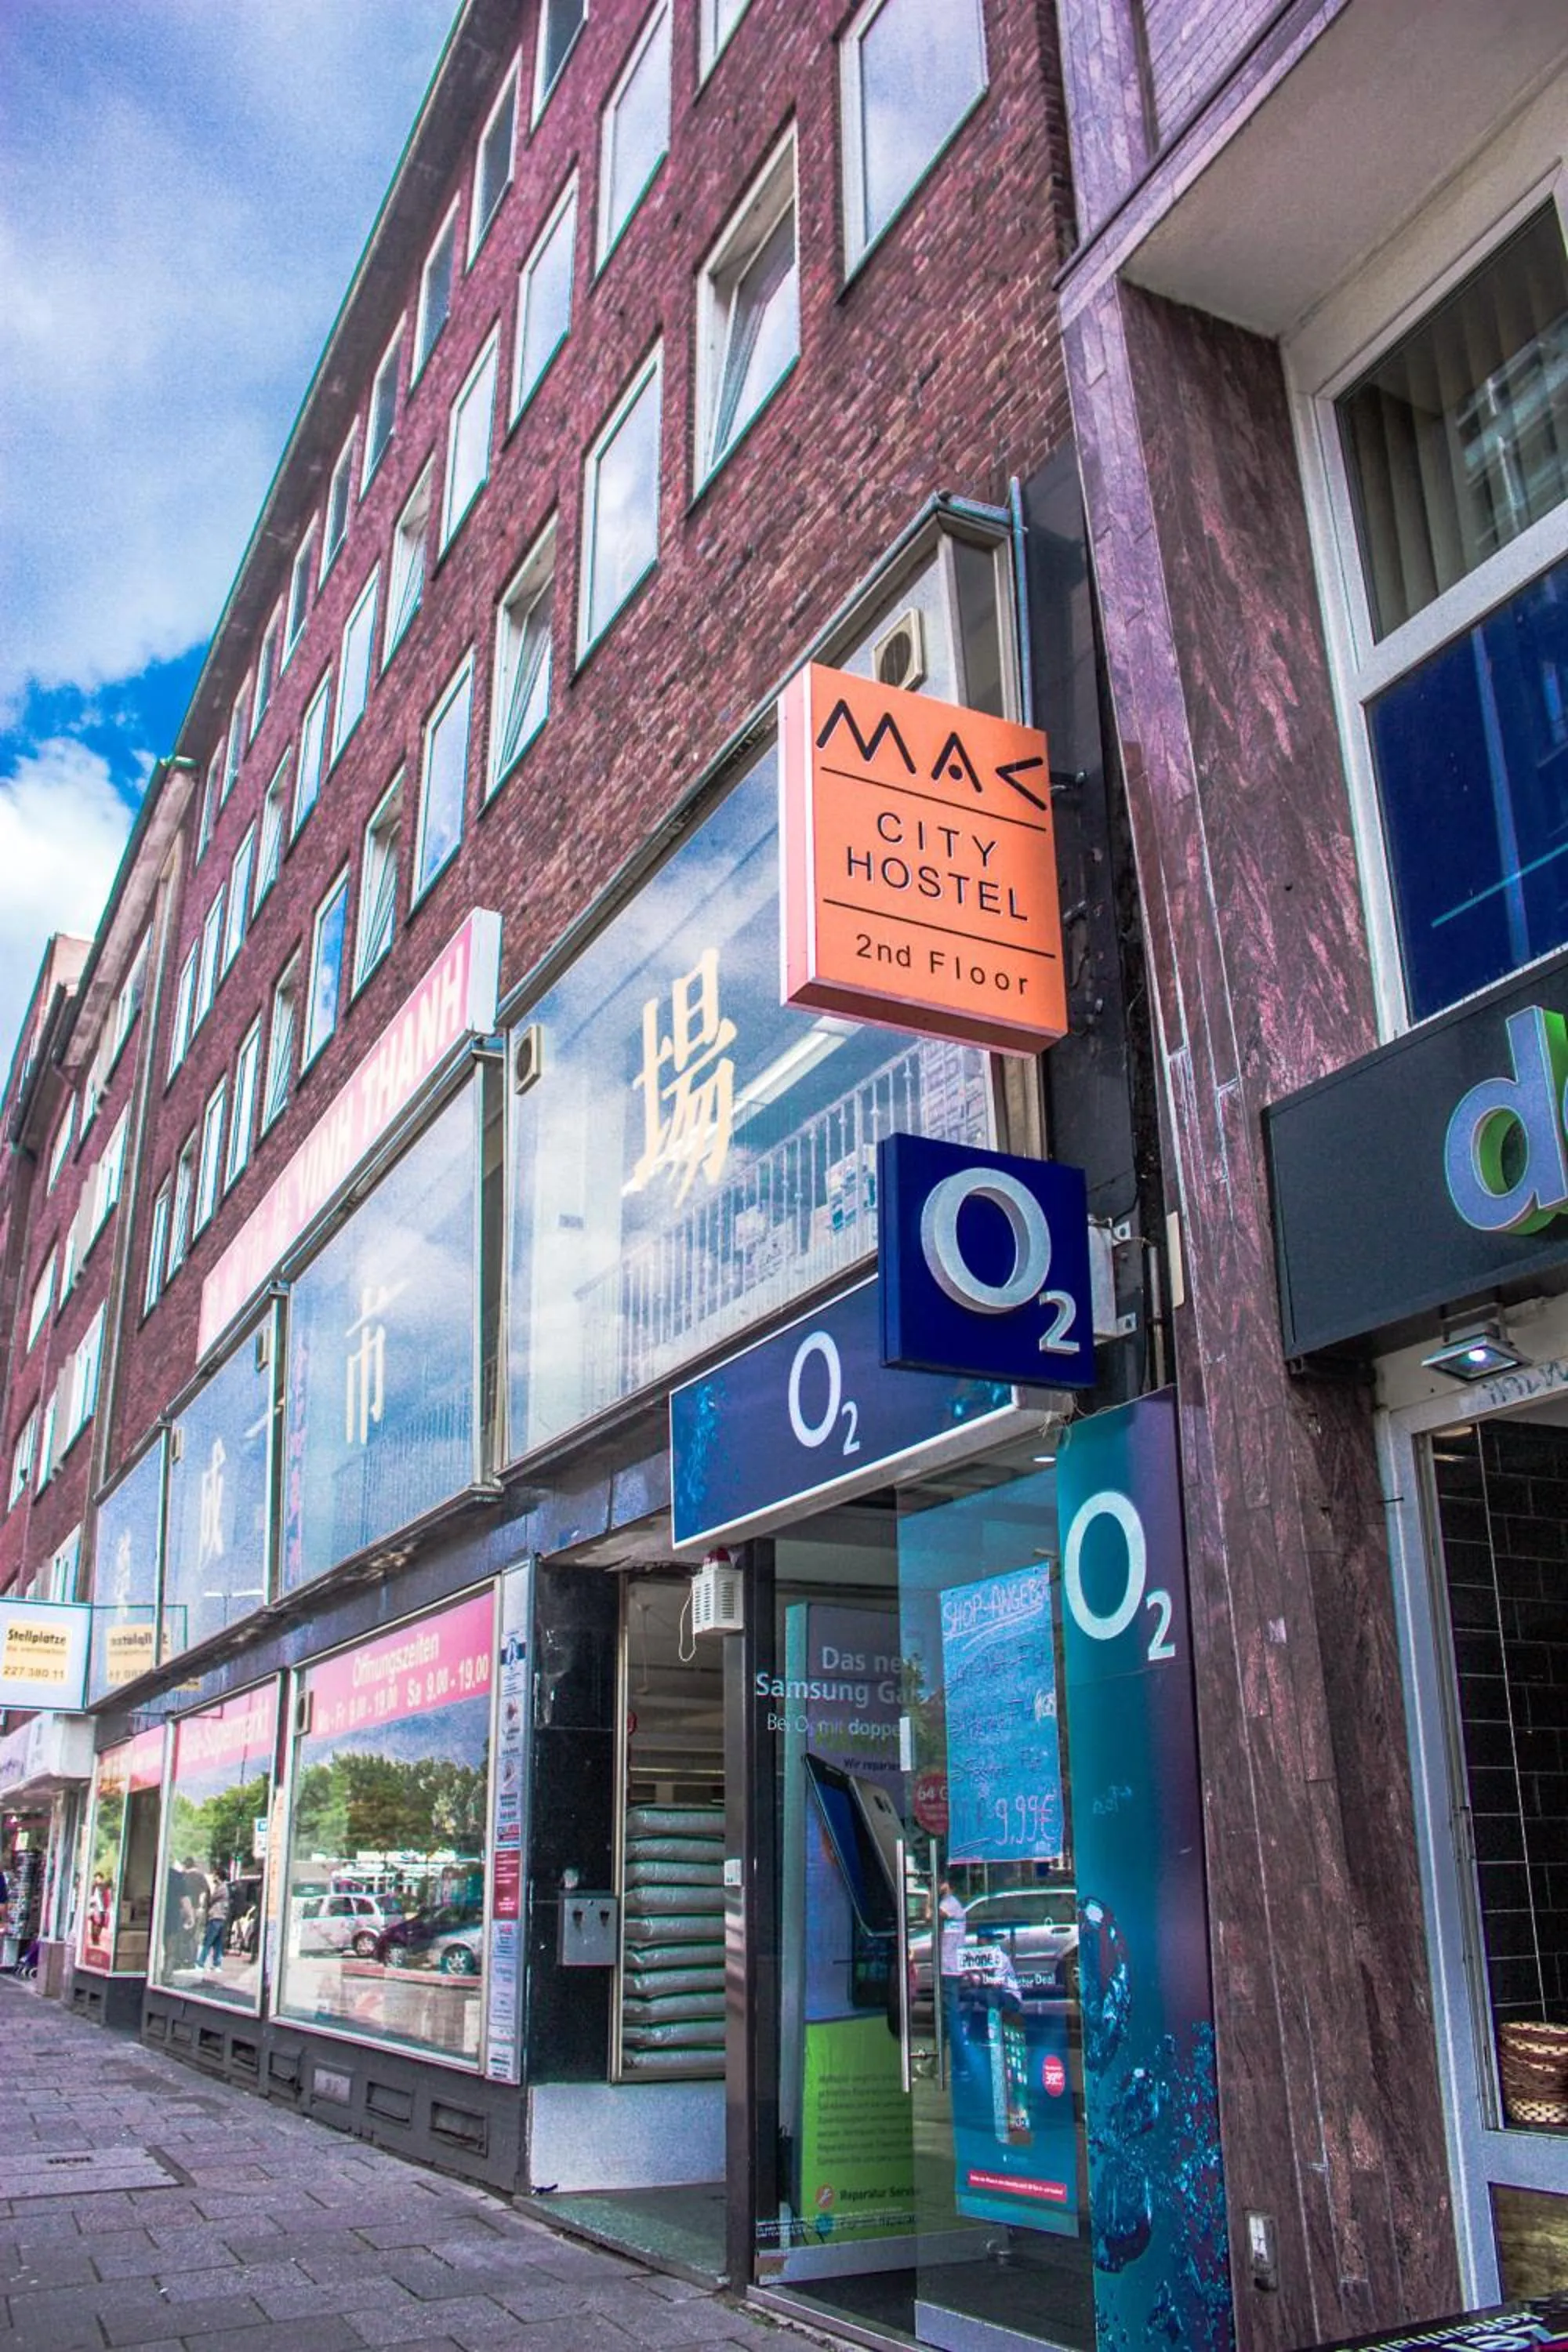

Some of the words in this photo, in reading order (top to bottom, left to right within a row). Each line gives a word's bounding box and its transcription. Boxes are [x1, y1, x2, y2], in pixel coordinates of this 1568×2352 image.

[815, 699, 1047, 811] MAC
[877, 811, 998, 867] CITY
[847, 846, 1029, 921] HOSTEL
[855, 934, 912, 968] 2nd
[930, 952, 1029, 995] Floor
[297, 1091, 354, 1219] VINH
[361, 943, 464, 1131] THANH
[1444, 1004, 1568, 1236] d
[407, 1678, 421, 1708] Sa
[459, 1653, 488, 1692] 19.00
[822, 1646, 866, 1671] Das
[756, 1672, 869, 1708] Samsung
[849, 1719, 902, 1740] doppe
[918, 1784, 935, 1801] 64
